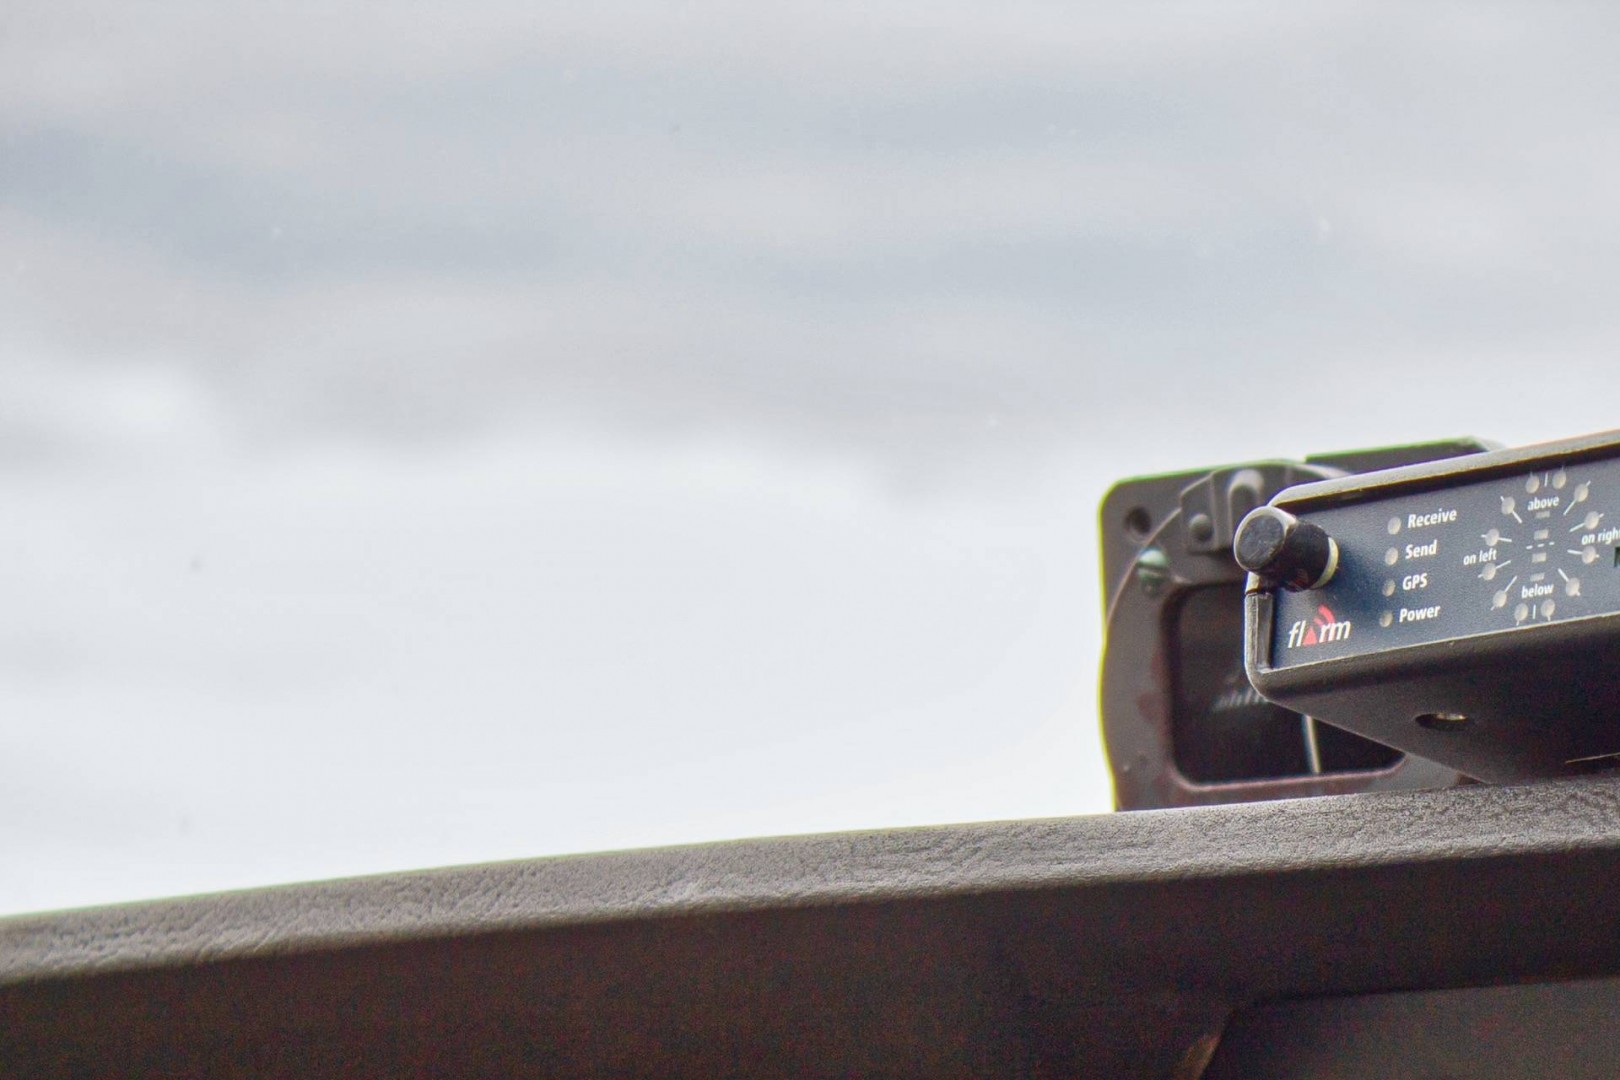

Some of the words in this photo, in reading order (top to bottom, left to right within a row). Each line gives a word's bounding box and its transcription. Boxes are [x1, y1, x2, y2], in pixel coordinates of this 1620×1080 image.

[1528, 496, 1560, 511] above
[1407, 508, 1458, 529] Receive
[1581, 534, 1596, 546] on
[1405, 539, 1438, 560] Send
[1463, 554, 1478, 566] on
[1479, 548, 1498, 563] left
[1402, 572, 1429, 591] GPS
[1521, 583, 1555, 599] below
[1399, 605, 1441, 623] Power
